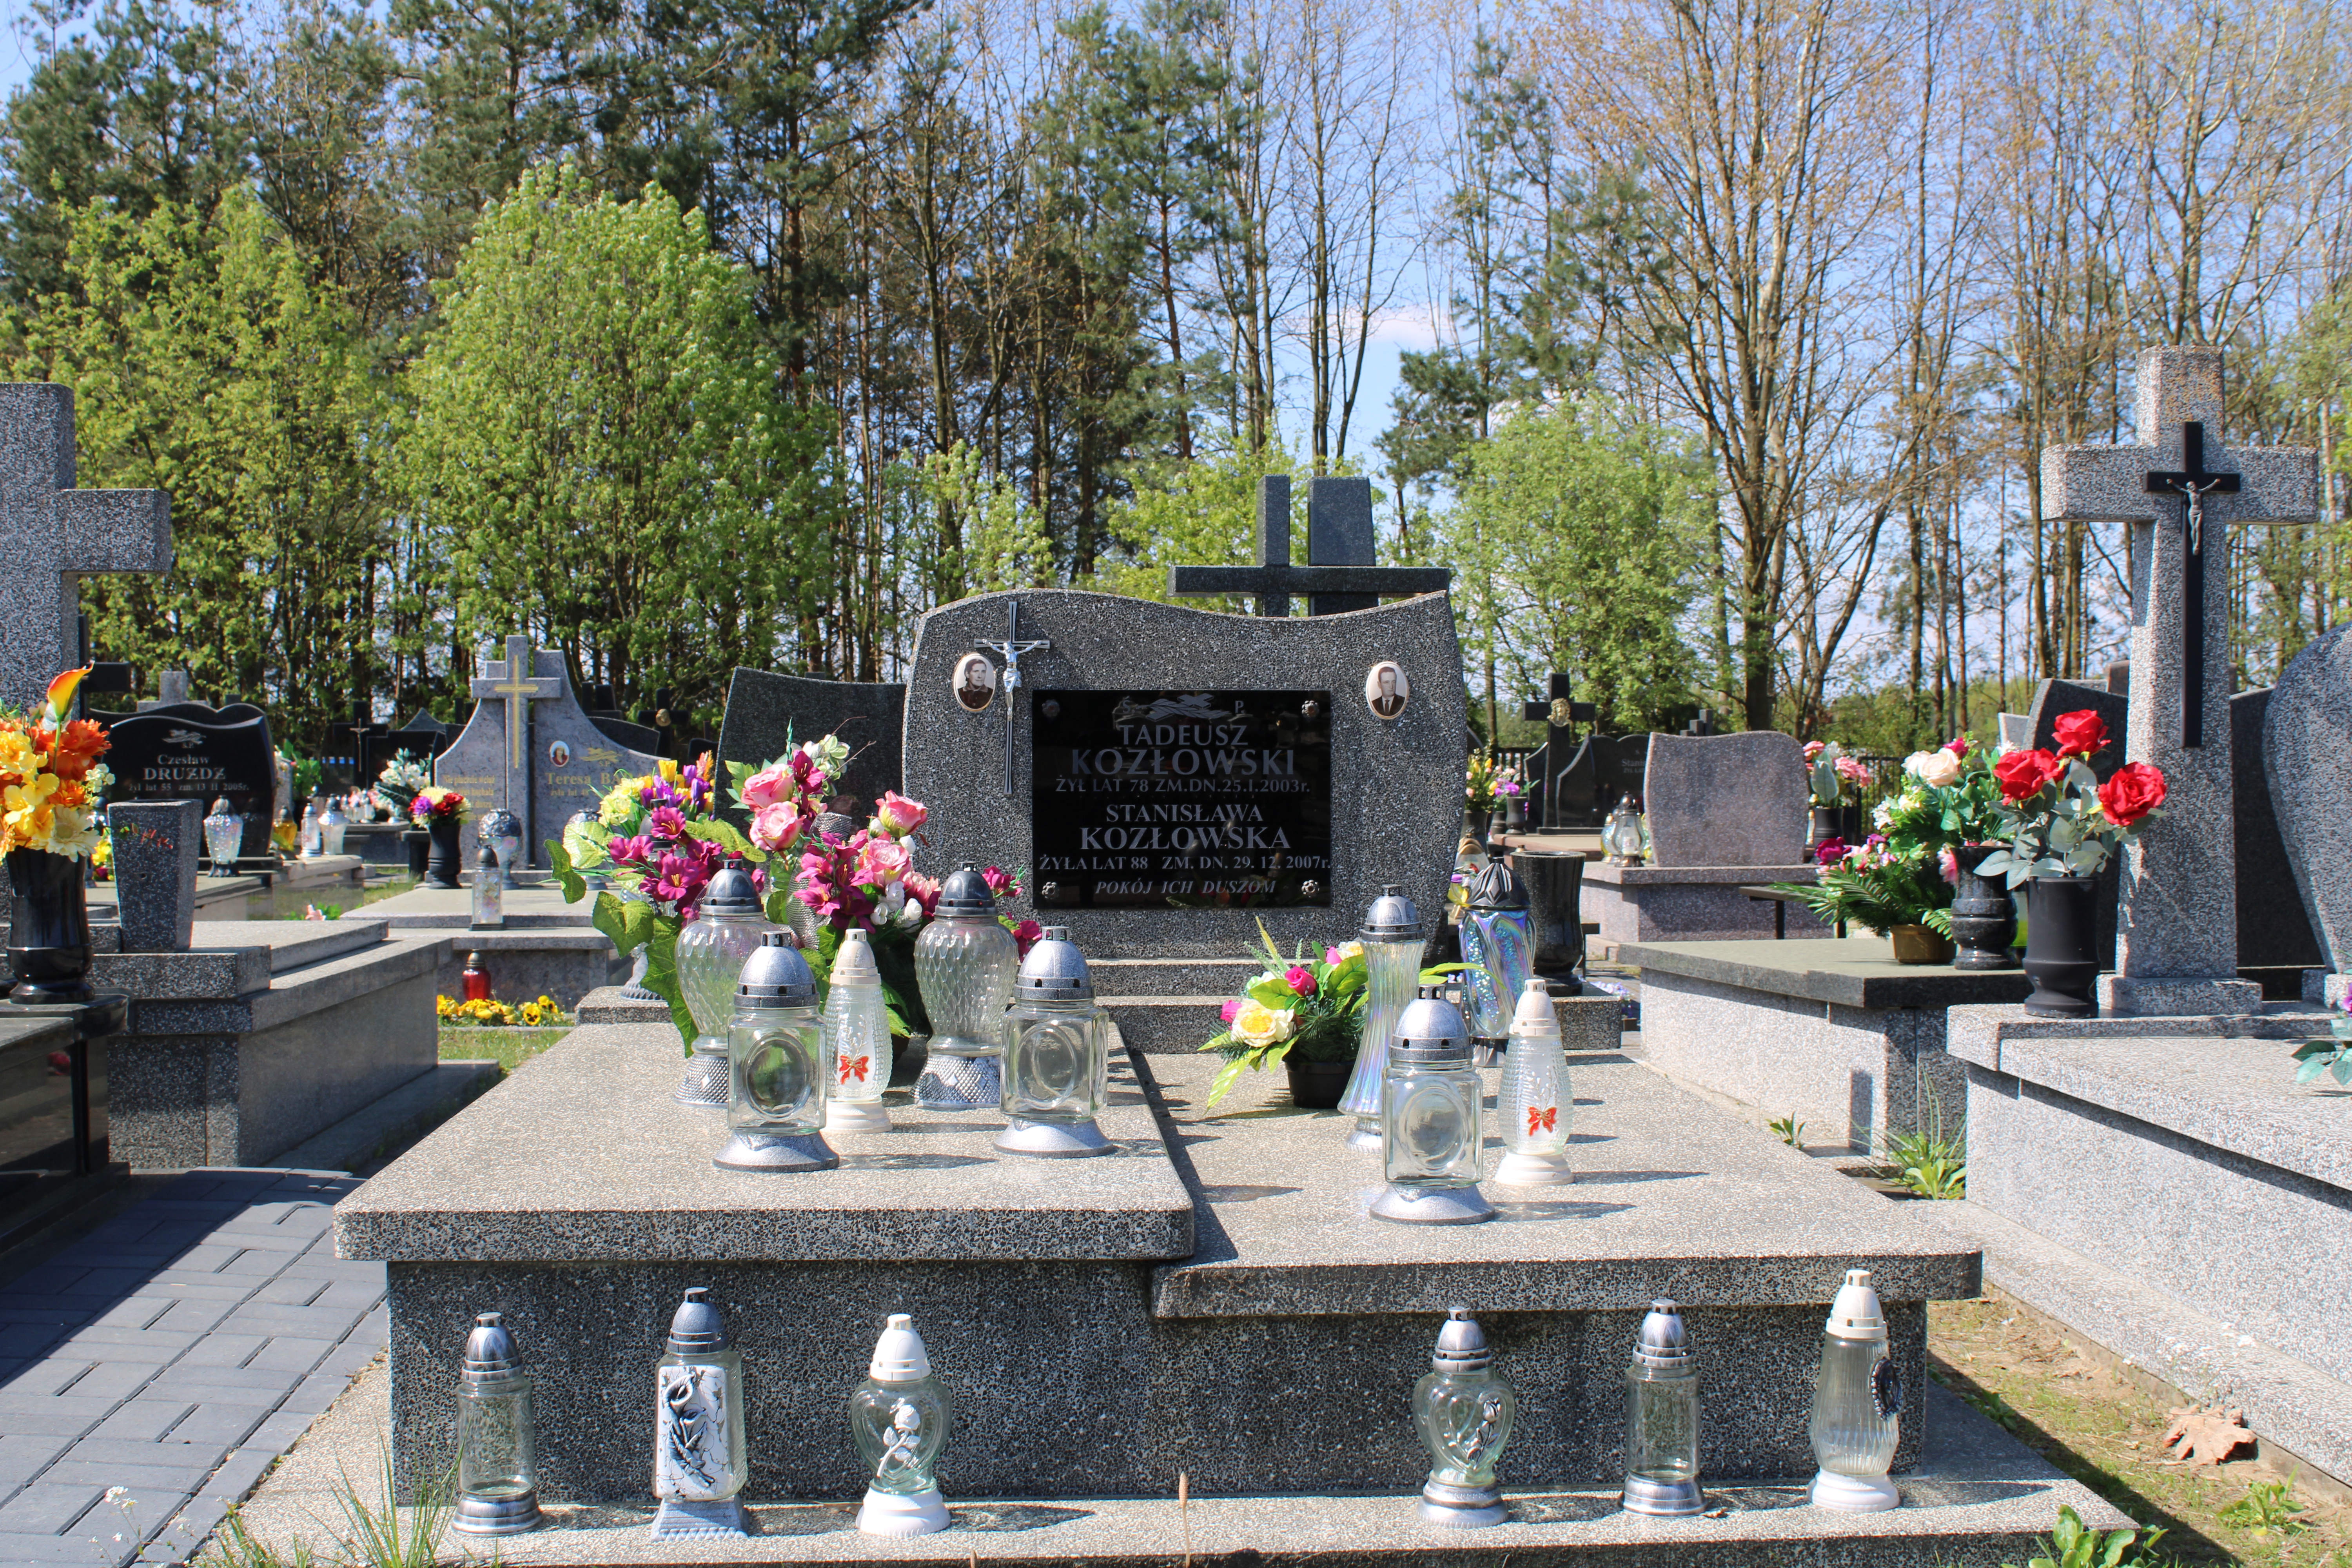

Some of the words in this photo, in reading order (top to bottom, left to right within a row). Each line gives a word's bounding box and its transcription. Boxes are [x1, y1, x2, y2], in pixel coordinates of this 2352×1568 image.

[1234, 700, 1245, 714] P.
[1118, 724, 1249, 745] TADEUSZ
[157, 754, 210, 764] Czesław
[1072, 749, 1294, 775] KOZŁOWSKI
[545, 772, 591, 784] Teresa
[1056, 775, 1086, 792] ŻYŁ
[1093, 779, 1123, 791] LAT
[1130, 779, 1149, 792] 78
[1106, 804, 1263, 822] STANISŁAWA
[1079, 827, 1291, 849] KOZŁOWSKA
[1039, 854, 1087, 869] ŻYŁA
[1093, 857, 1126, 869] LAT
[1131, 857, 1148, 869] 88
[1161, 856, 1194, 869] ZM.
[1200, 856, 1228, 869] DN.
[1233, 856, 1254, 869] 29.
[1261, 856, 1281, 869] 12.
[1286, 856, 1331, 869] 2007r.
[1095, 878, 1154, 894] POKÓJ
[1161, 880, 1194, 894] ICH
[1201, 880, 1277, 893] DUSZOM
